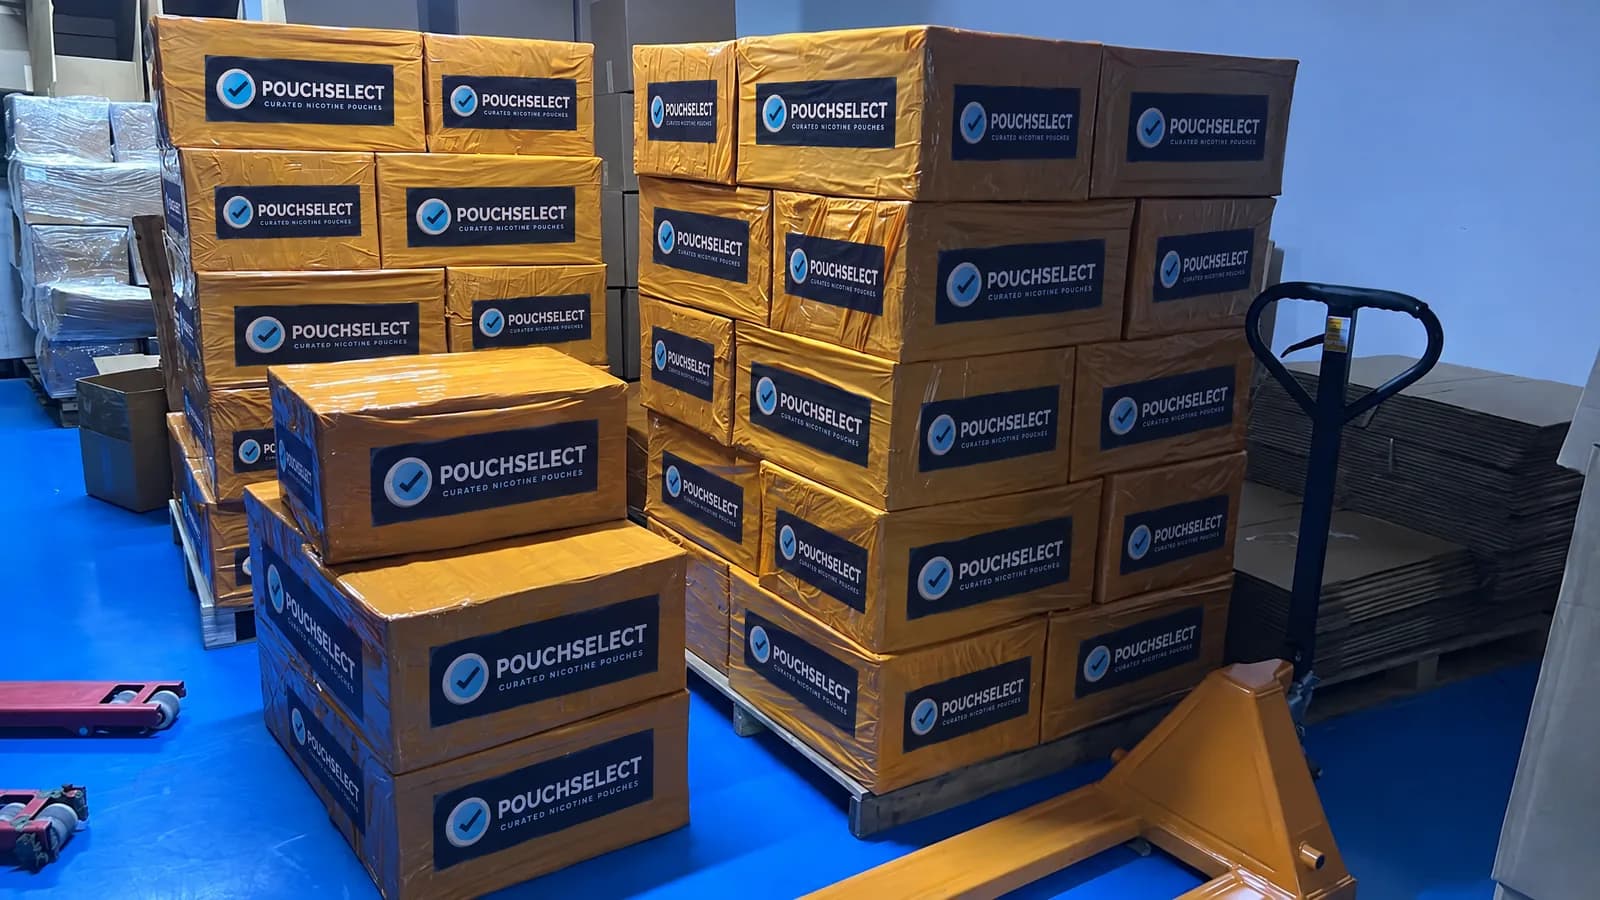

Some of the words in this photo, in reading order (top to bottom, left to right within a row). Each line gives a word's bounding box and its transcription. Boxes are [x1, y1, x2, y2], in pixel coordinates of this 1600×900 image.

[262, 80, 384, 100] POUCHSELECT
[482, 93, 569, 108] POUCHSELECT
[665, 102, 712, 115] POUCHSELECT
[791, 102, 886, 119] POUCHSELECT
[990, 113, 1071, 129] POUCHSELECT
[1169, 119, 1259, 134] POUCHSELECT
[257, 203, 352, 216] POUCHSELECT
[456, 206, 566, 221] POUCHSELECT
[677, 231, 742, 256] POUCHSELECT
[810, 259, 878, 285] POUCHSELECT
[987, 263, 1095, 288] POUCHSELECT
[1183, 250, 1248, 272] POUCHSELECT
[988, 291, 1021, 300] CURATED
[1024, 288, 1057, 297] NICOTINE
[1060, 285, 1092, 294] POUCHES
[292, 321, 409, 339] POUCHSELECT
[508, 309, 584, 325] POUCHSELECT
[667, 350, 710, 377] POUCHSELECT
[780, 392, 862, 436] POUCHSELECT
[1142, 386, 1228, 417] POUCHSELECT
[780, 411, 803, 426] CURATED
[805, 421, 830, 436] NICOTINE
[832, 431, 859, 447] POUCHES
[960, 409, 1050, 438] POUCHSELECT
[961, 438, 988, 448] CURATED
[440, 444, 587, 484] POUCHSELECT
[442, 483, 488, 497] CURATED
[492, 476, 536, 489] NICOTINE
[541, 468, 583, 481] POUCHES
[683, 479, 738, 519] POUCHSELECT
[1154, 514, 1222, 543] POUCHSELECT
[798, 539, 861, 585] POUCHSELECT
[959, 539, 1063, 579] POUCHSELECT
[959, 577, 992, 591] CURATED
[994, 569, 1026, 582] NICOTINE
[285, 591, 355, 682] POUCHSELECT
[496, 623, 647, 678] POUCHSELECT
[1114, 624, 1196, 663] POUCHSELECT
[498, 673, 544, 691] CURATED
[549, 660, 595, 678] NICOTINE
[600, 649, 643, 666] POUCHES
[773, 644, 849, 706] POUCHSELECT
[942, 678, 1024, 716] POUCHSELECT
[307, 728, 359, 804] POUCHSELECT
[498, 755, 641, 819] POUCHSELECT
[500, 810, 545, 831] CURATED
[549, 794, 592, 815] NICOTINE
[597, 779, 638, 799] POUCHES
